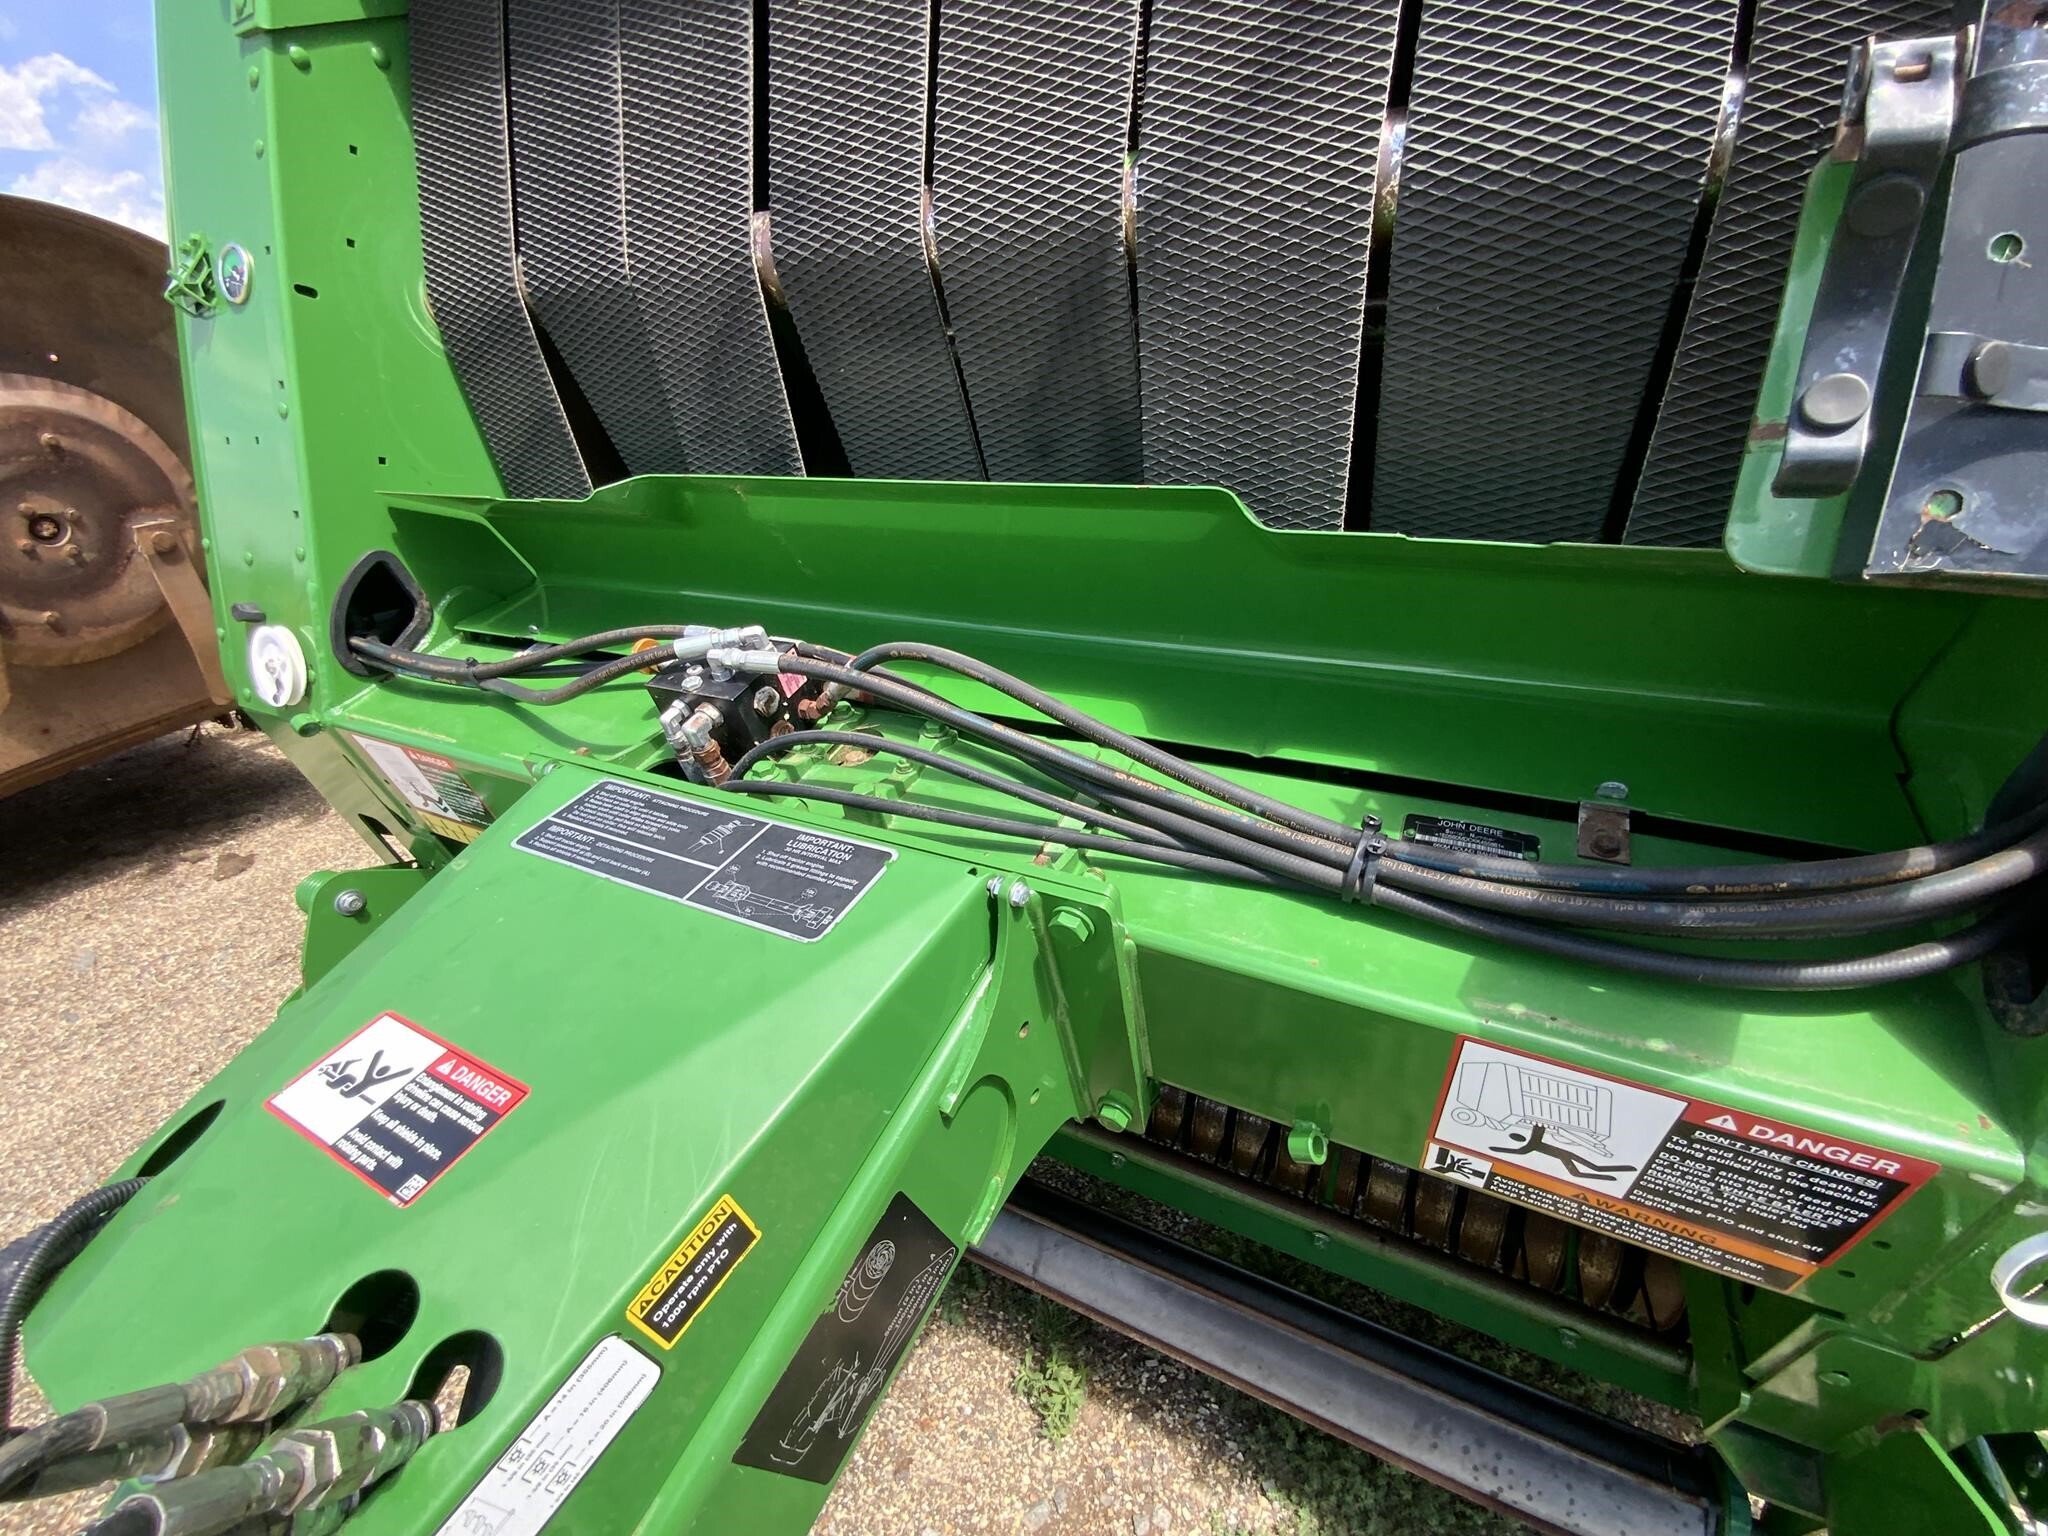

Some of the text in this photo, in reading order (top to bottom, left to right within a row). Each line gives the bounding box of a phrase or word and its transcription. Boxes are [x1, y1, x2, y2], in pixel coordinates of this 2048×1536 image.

[605, 784, 651, 800] IMPORTANT:
[548, 825, 595, 844] IMPORTANT:
[787, 840, 852, 861] LUBRICATION
[797, 834, 854, 853] IMPORTANT:
[1437, 820, 1465, 830] JOHN
[1469, 825, 1503, 836] DEERE
[801, 851, 828, 862] INTERVAL
[452, 1067, 511, 1105] DANGER
[371, 1109, 390, 1126] Keep
[1666, 1143, 1704, 1158] being
[1707, 1156, 1751, 1171] pulled
[1754, 1169, 1782, 1180] into
[1786, 1178, 1809, 1188] the
[1672, 1136, 1877, 1200] To avoid injury or death by
[1695, 1131, 1882, 1188] DON'T TAKE CHANCES!
[1750, 1126, 1899, 1173] DANGER
[1630, 1195, 1676, 1213] engine.
[1640, 1181, 1736, 1215] can release it.
[1644, 1176, 1808, 1229] material faster than you
[1648, 1170, 1827, 1228] RUNNING. The baler feeds
[1652, 1164, 1843, 1226] feed area WHILE BALER IS
[1659, 1152, 1869, 1218] DO NOT attempt to feed crop
[1674, 1164, 1711, 1178] twine
[1715, 1176, 1742, 1188] into
[1747, 1186, 1783, 1200] baler
[1807, 1205, 1857, 1223] unplug
[1490, 1185, 1517, 1198] Keep
[1521, 1196, 1554, 1210] hands
[1559, 1210, 1578, 1219] out
[1597, 1222, 1612, 1230] its
[1615, 1229, 1642, 1241] path
[1646, 1240, 1669, 1250] and
[1673, 1248, 1698, 1260] turn
[1703, 1259, 1721, 1267] off
[1724, 1266, 1762, 1281] power.
[1493, 1180, 1712, 1259] Twine arm can move unexpectedly.
[1494, 1176, 1525, 1189] Avoid
[1528, 1188, 1578, 1208] crushing
[1582, 1205, 1630, 1225] between
[1635, 1223, 1667, 1238] twine
[1671, 1236, 1694, 1247] arm
[1698, 1246, 1722, 1256] and
[1725, 1255, 1764, 1270] cutter.
[1594, 1200, 1716, 1244] WARNING
[1634, 1190, 1823, 1252] Disengage PTO and shut off
[651, 1208, 727, 1296] CAUTION
[654, 1224, 737, 1322] Operate only with
[663, 1249, 729, 1327] 1000 rpm PTO
